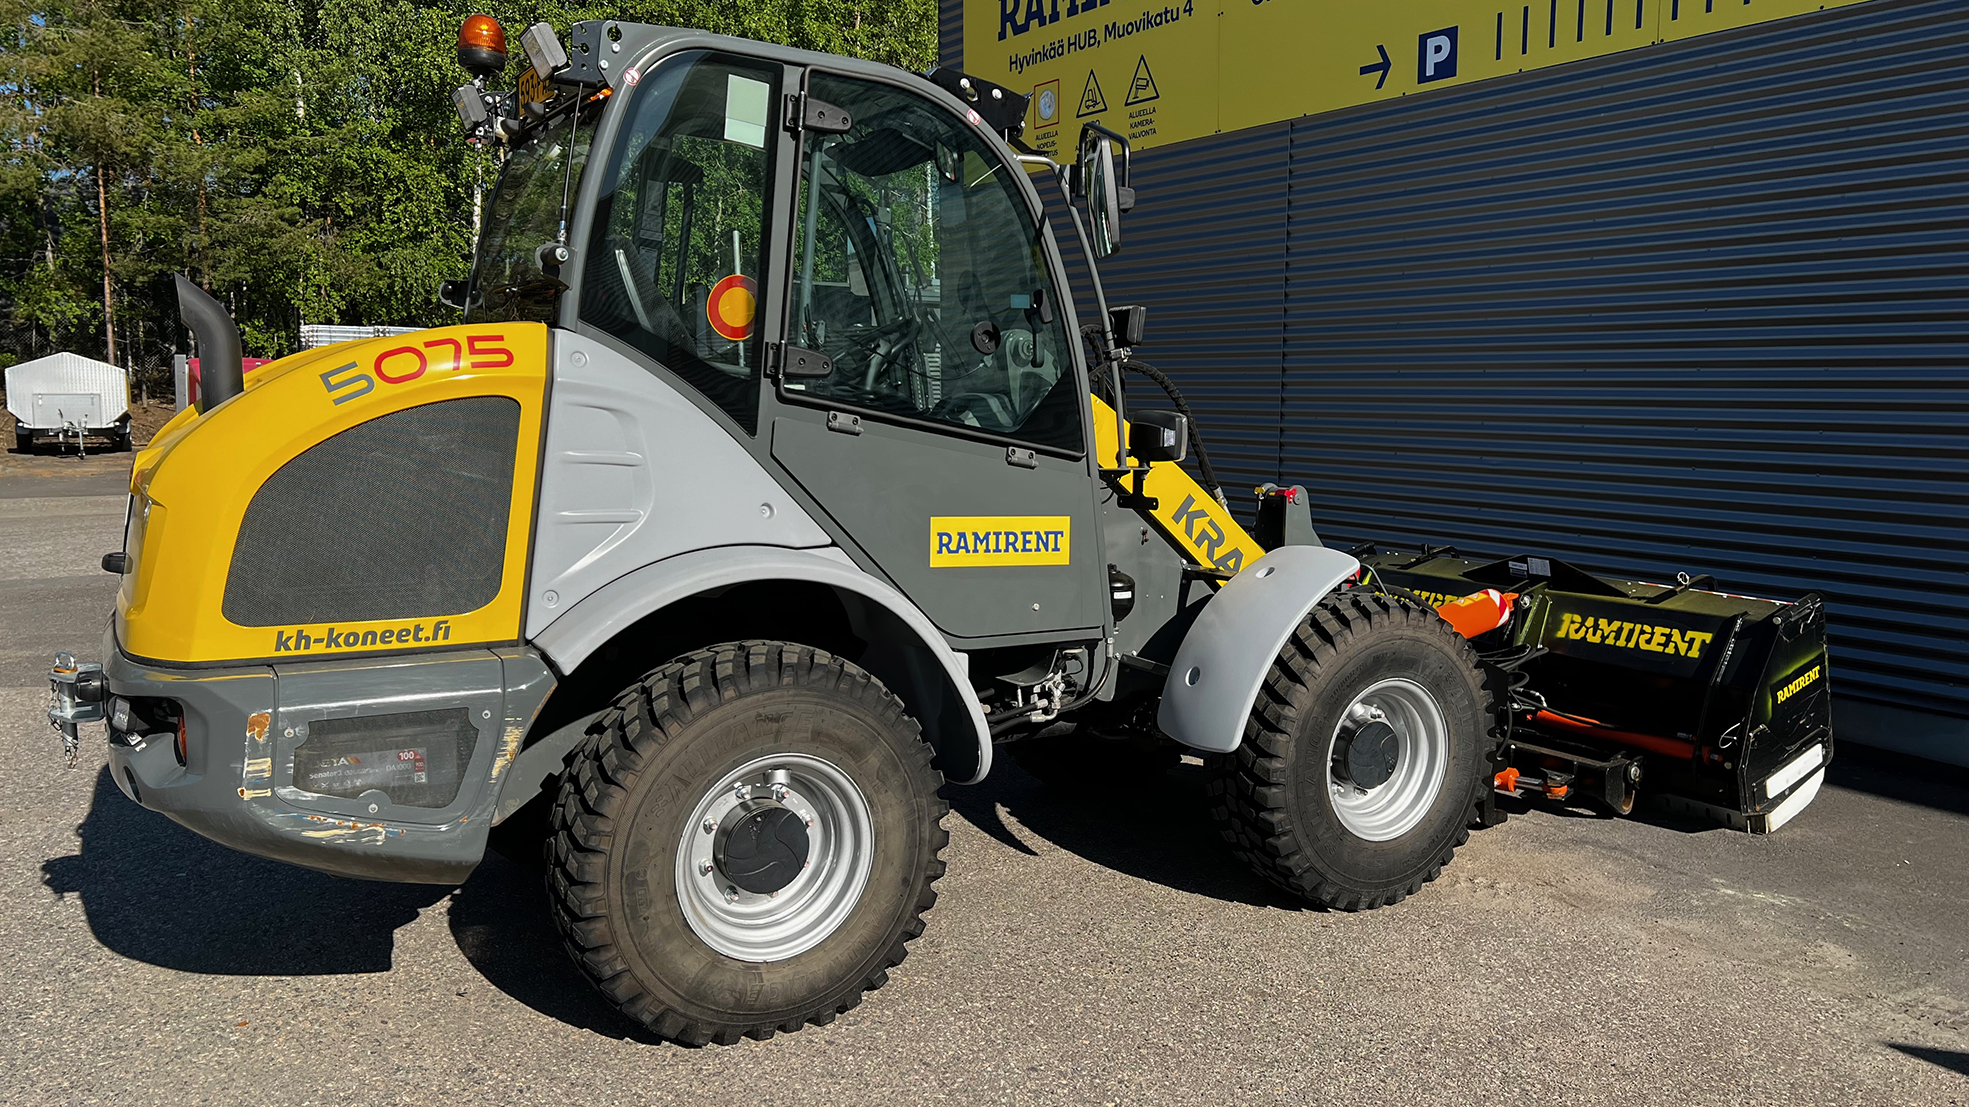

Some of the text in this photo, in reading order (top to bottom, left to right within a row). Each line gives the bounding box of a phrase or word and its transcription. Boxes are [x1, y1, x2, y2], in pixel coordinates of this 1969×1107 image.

[1009, 39, 1065, 75] Hyvinkää
[1067, 28, 1101, 55] HUB,
[1104, 7, 1180, 43] Muovikatu
[1183, 0, 1194, 18] 4
[1426, 35, 1450, 77] P
[1128, 107, 1157, 119] ALUEELLA
[1129, 119, 1156, 130] KAMERA-
[1035, 130, 1058, 141] ALUEELLA
[1036, 140, 1057, 150] NOPEUS-
[1128, 128, 1157, 140] VALVONTA
[319, 335, 514, 406] 5075
[937, 531, 1064, 554] RAMIRENT
[274, 620, 451, 652] kh-koneet.fi
[1555, 612, 1714, 659] RAMIRENT
[1777, 665, 1820, 703] RAMIRENT
[398, 751, 415, 761] 100
